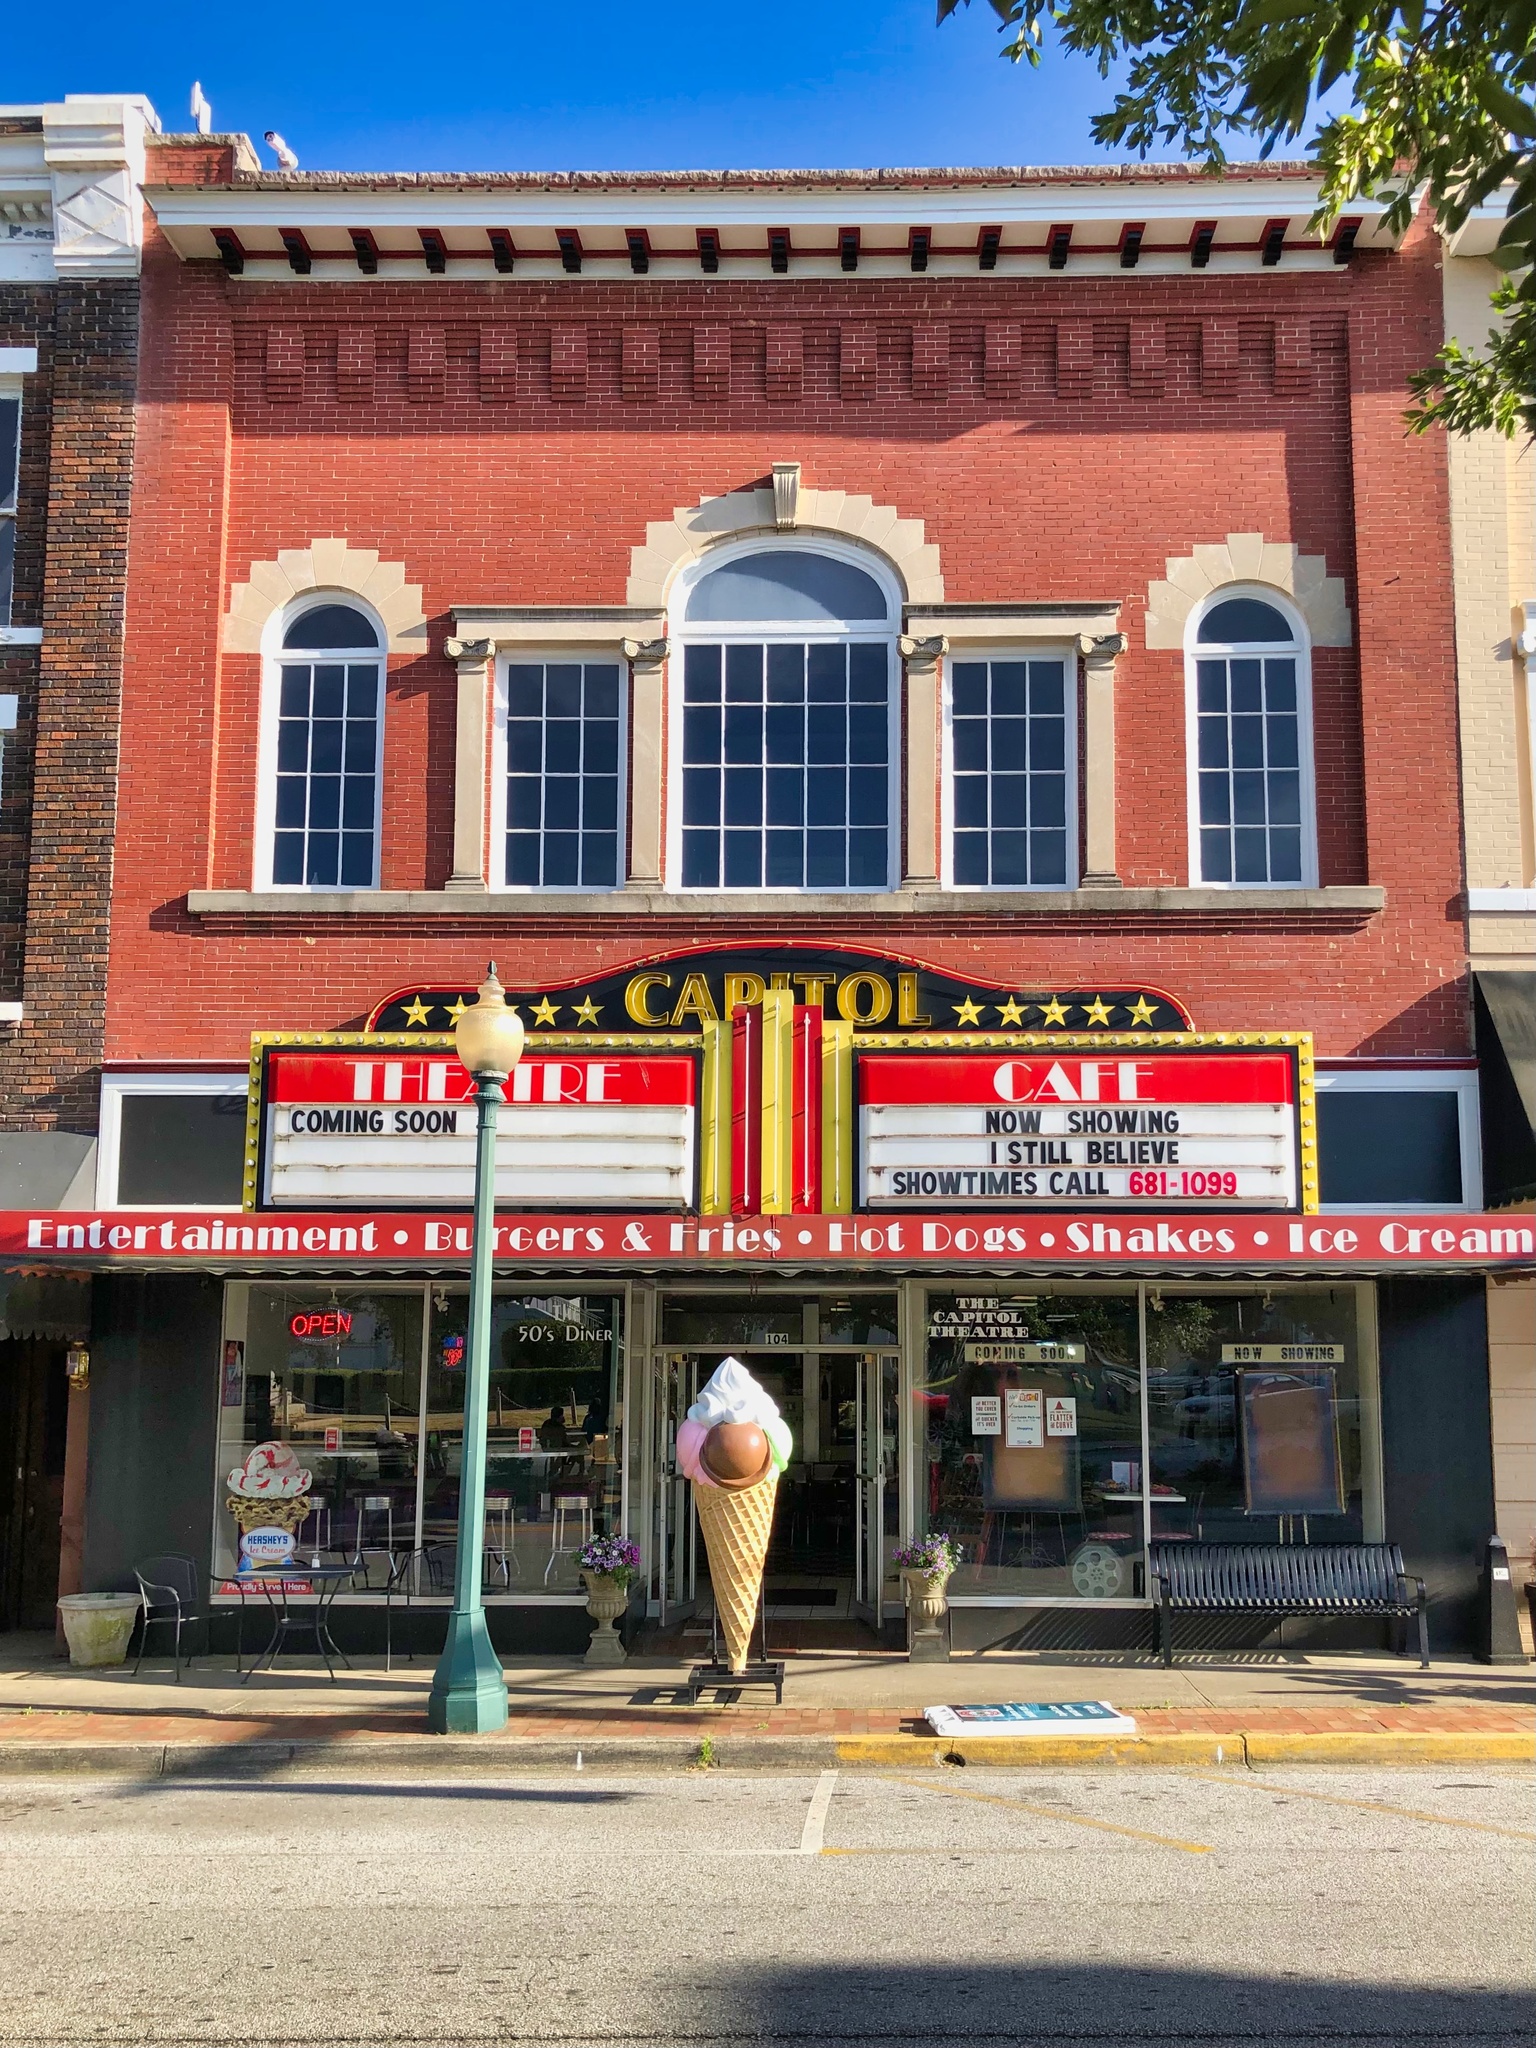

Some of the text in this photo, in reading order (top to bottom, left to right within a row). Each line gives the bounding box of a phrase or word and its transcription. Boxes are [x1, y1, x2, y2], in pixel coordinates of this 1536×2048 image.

[993, 1060, 1156, 1103] CAFE
[291, 1109, 458, 1133] COMING SOON
[985, 1110, 1180, 1134] NOW SHOWING
[990, 1141, 1180, 1164] I STILL BELIEVE
[892, 1171, 1237, 1195] SHOWTIMES CALL 681-1099
[27, 1218, 379, 1252] Entertainment
[621, 1221, 653, 1252] &
[669, 1221, 781, 1253] Fries
[828, 1221, 906, 1252] Hot
[922, 1222, 1027, 1253] Dogs
[1066, 1222, 1236, 1253] Shakes
[1288, 1222, 1359, 1253] Ice
[1379, 1222, 1534, 1254] Cream
[955, 1297, 1000, 1309] THE
[291, 1313, 353, 1335] OPEN
[932, 1311, 1023, 1324] CAPITOL
[518, 1325, 555, 1343] 50's
[927, 1326, 1029, 1338] THEATRE
[767, 1334, 788, 1345] 104
[975, 1346, 1026, 1360] COMING
[1234, 1347, 1335, 1360] NOW SHOWING
[247, 1535, 289, 1545] HERSHEY'S
[261, 1545, 286, 1554] Cream
[287, 1583, 307, 1591] Here
